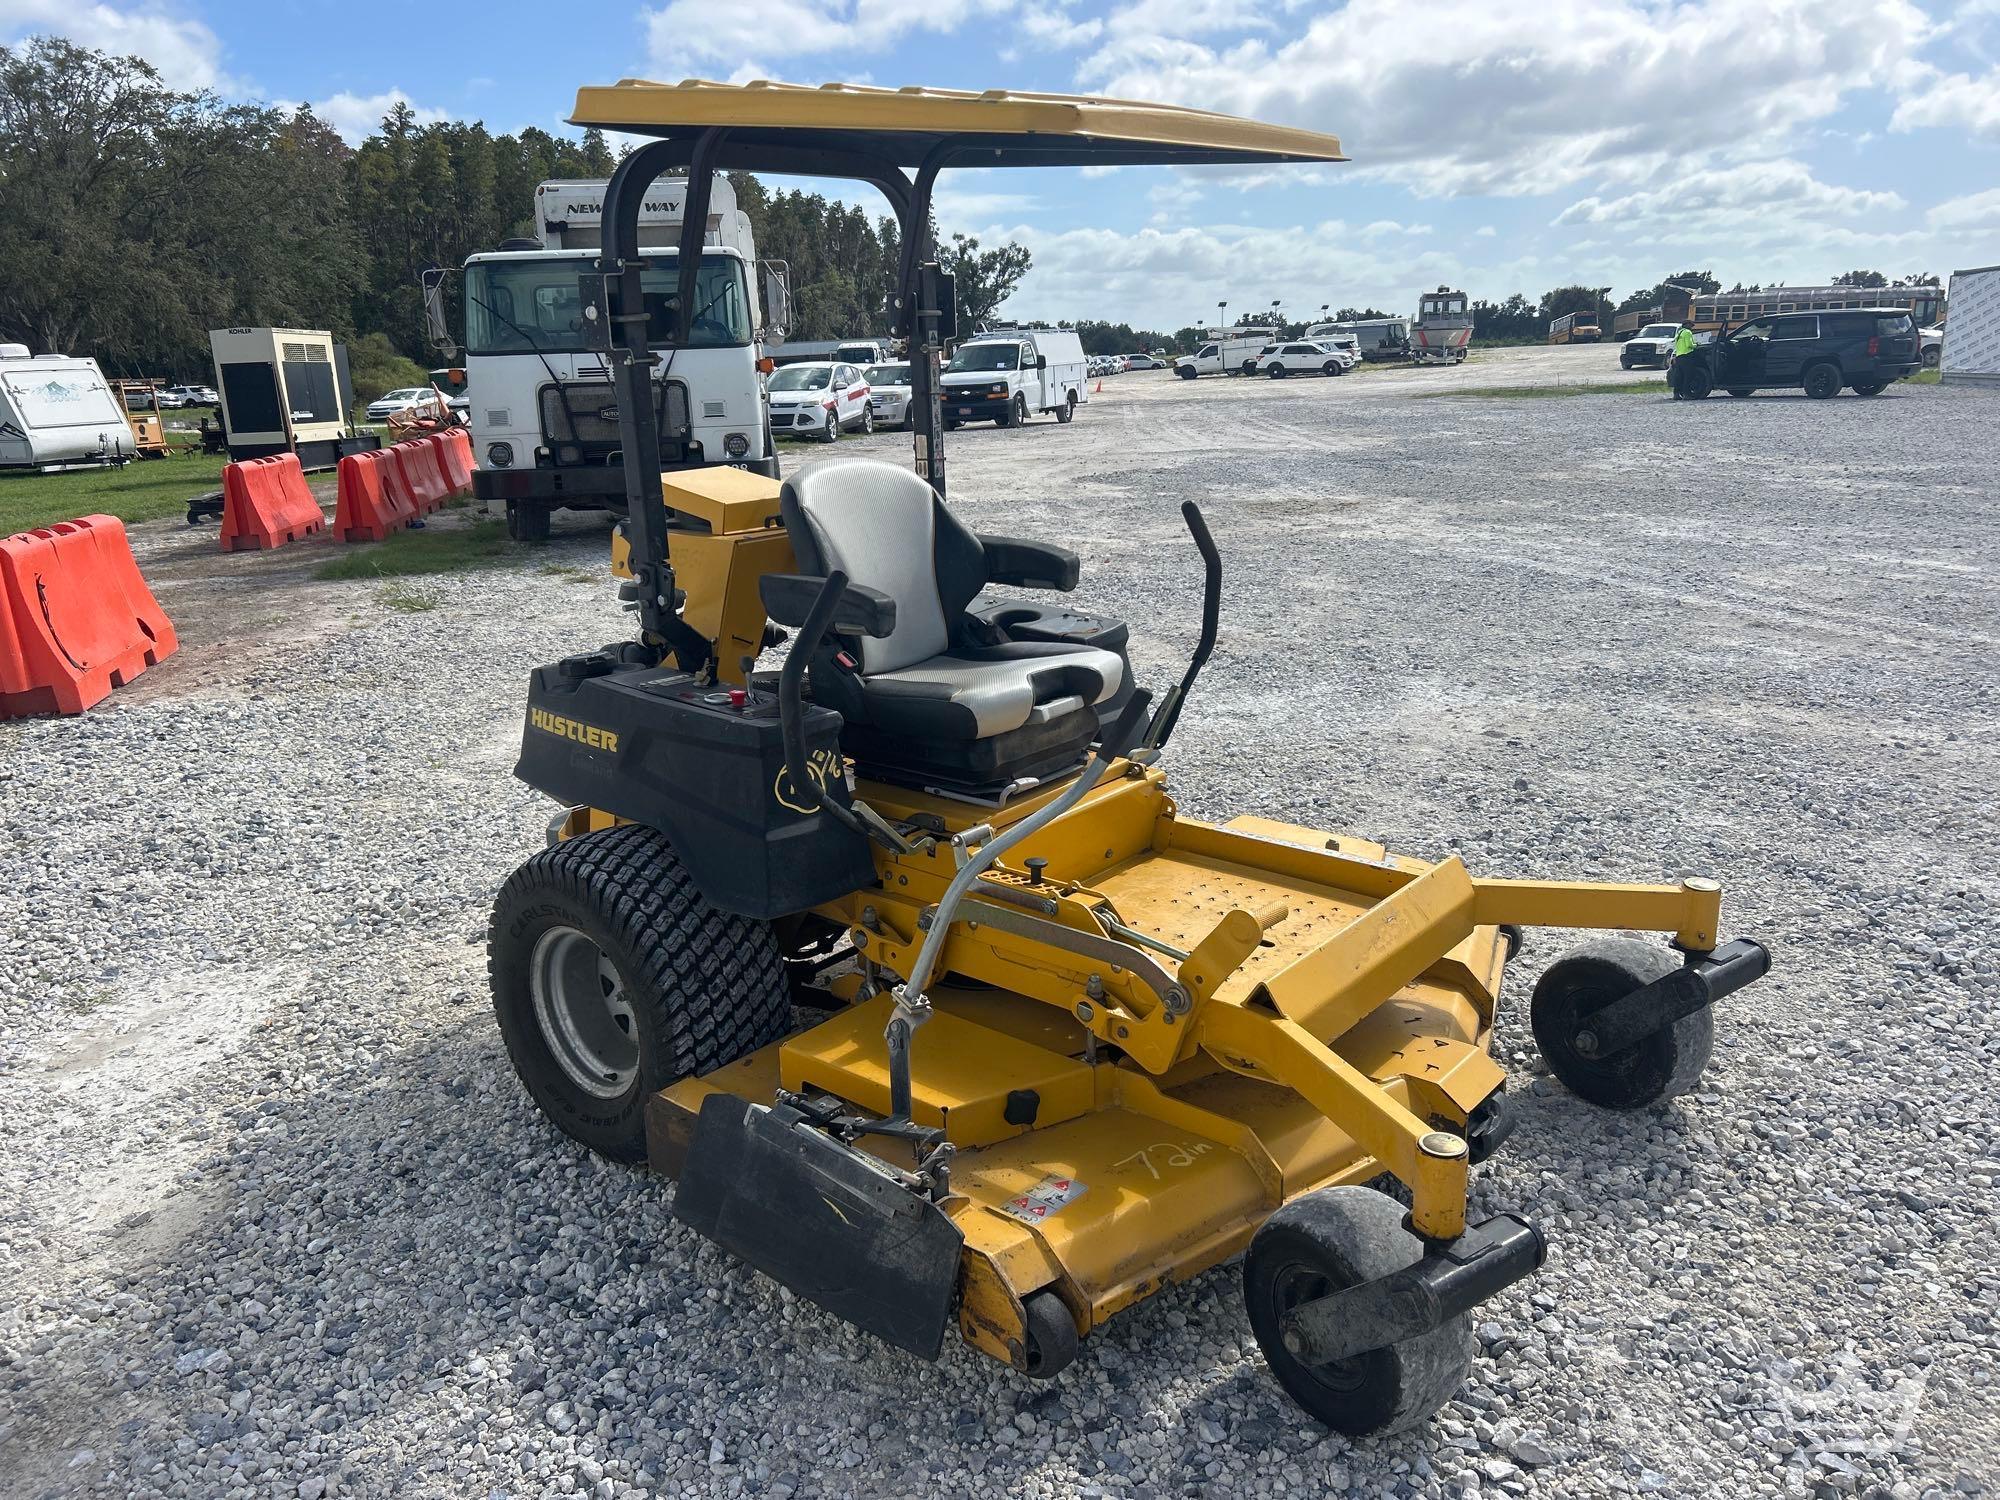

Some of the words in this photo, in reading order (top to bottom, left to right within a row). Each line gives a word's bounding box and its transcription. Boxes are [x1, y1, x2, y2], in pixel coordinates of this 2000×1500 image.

[567, 204, 602, 214] NEW
[645, 202, 679, 212] WAY
[531, 707, 618, 753] HUSTLER
